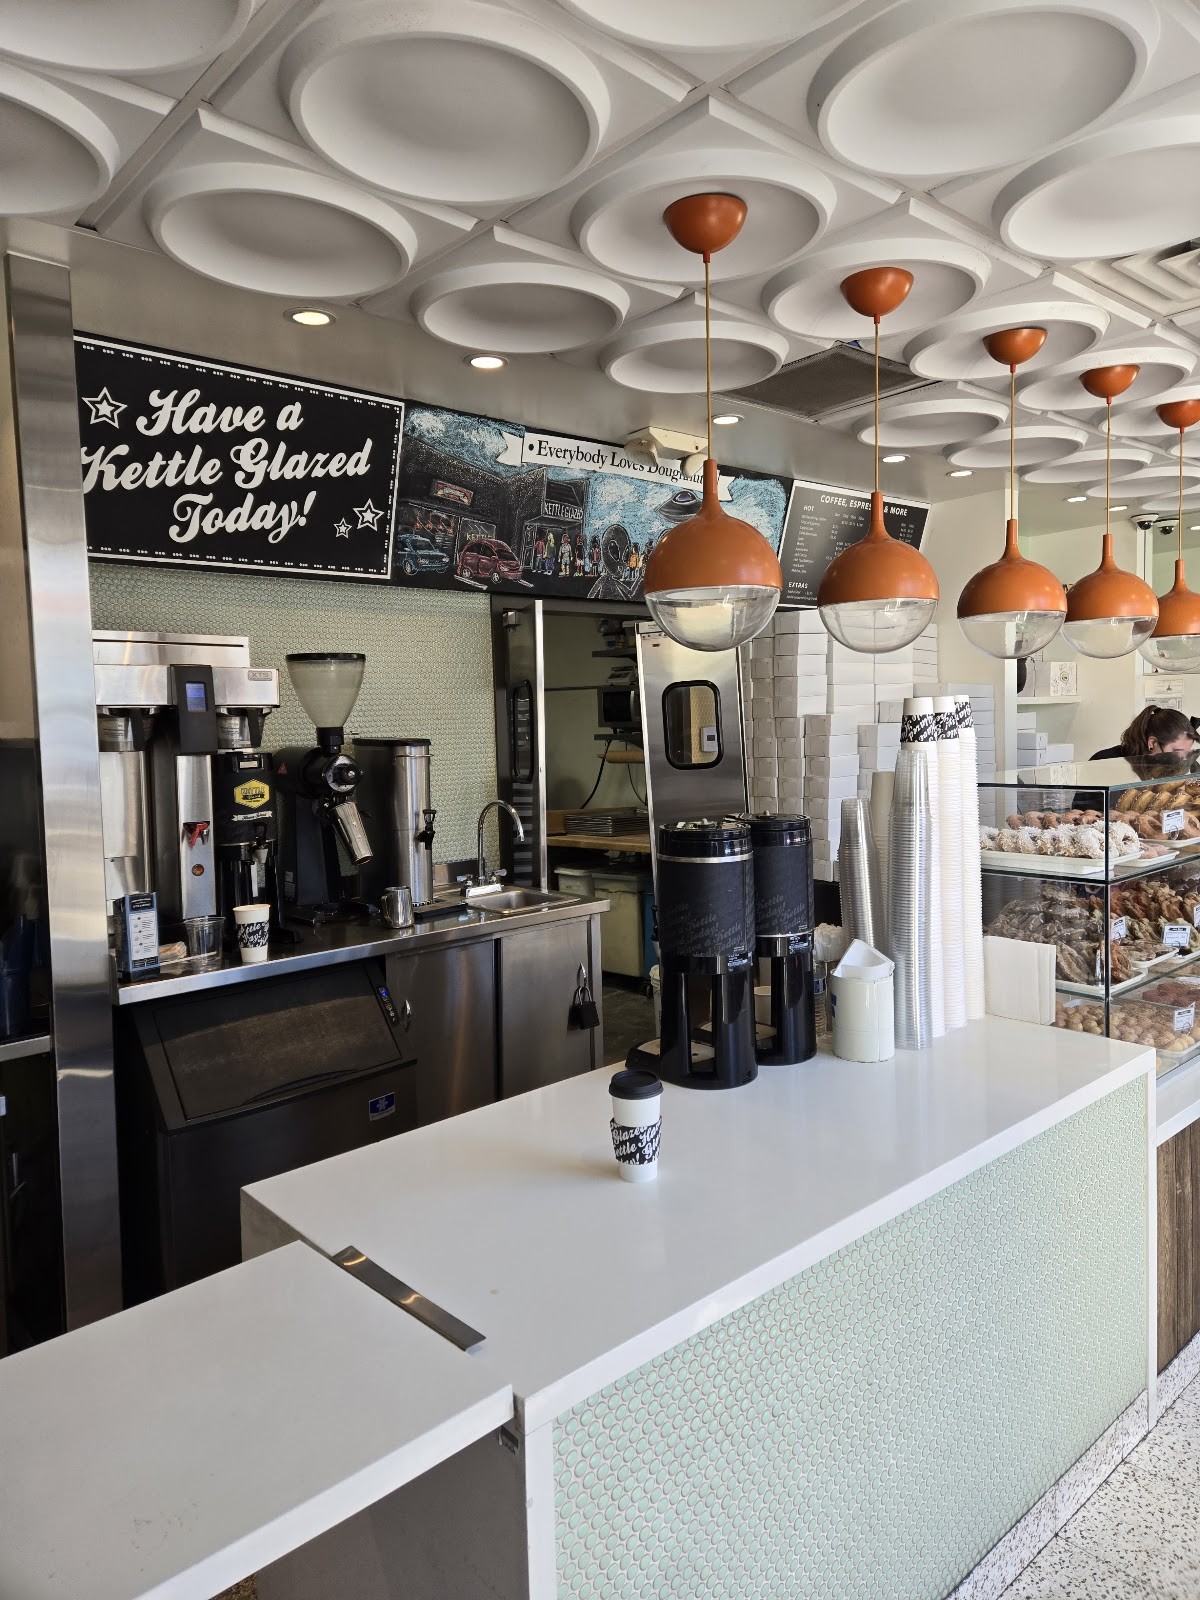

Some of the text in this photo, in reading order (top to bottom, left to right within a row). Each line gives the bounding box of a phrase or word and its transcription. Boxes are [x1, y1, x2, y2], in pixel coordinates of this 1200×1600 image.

[136, 388, 303, 436] Have a
[80, 437, 373, 494] Kettle Glazed
[536, 439, 608, 470] Everybody
[610, 451, 645, 472] Loves
[168, 490, 317, 544] Today!
[820, 494, 848, 508] COFFEE,
[889, 506, 908, 517] MORE
